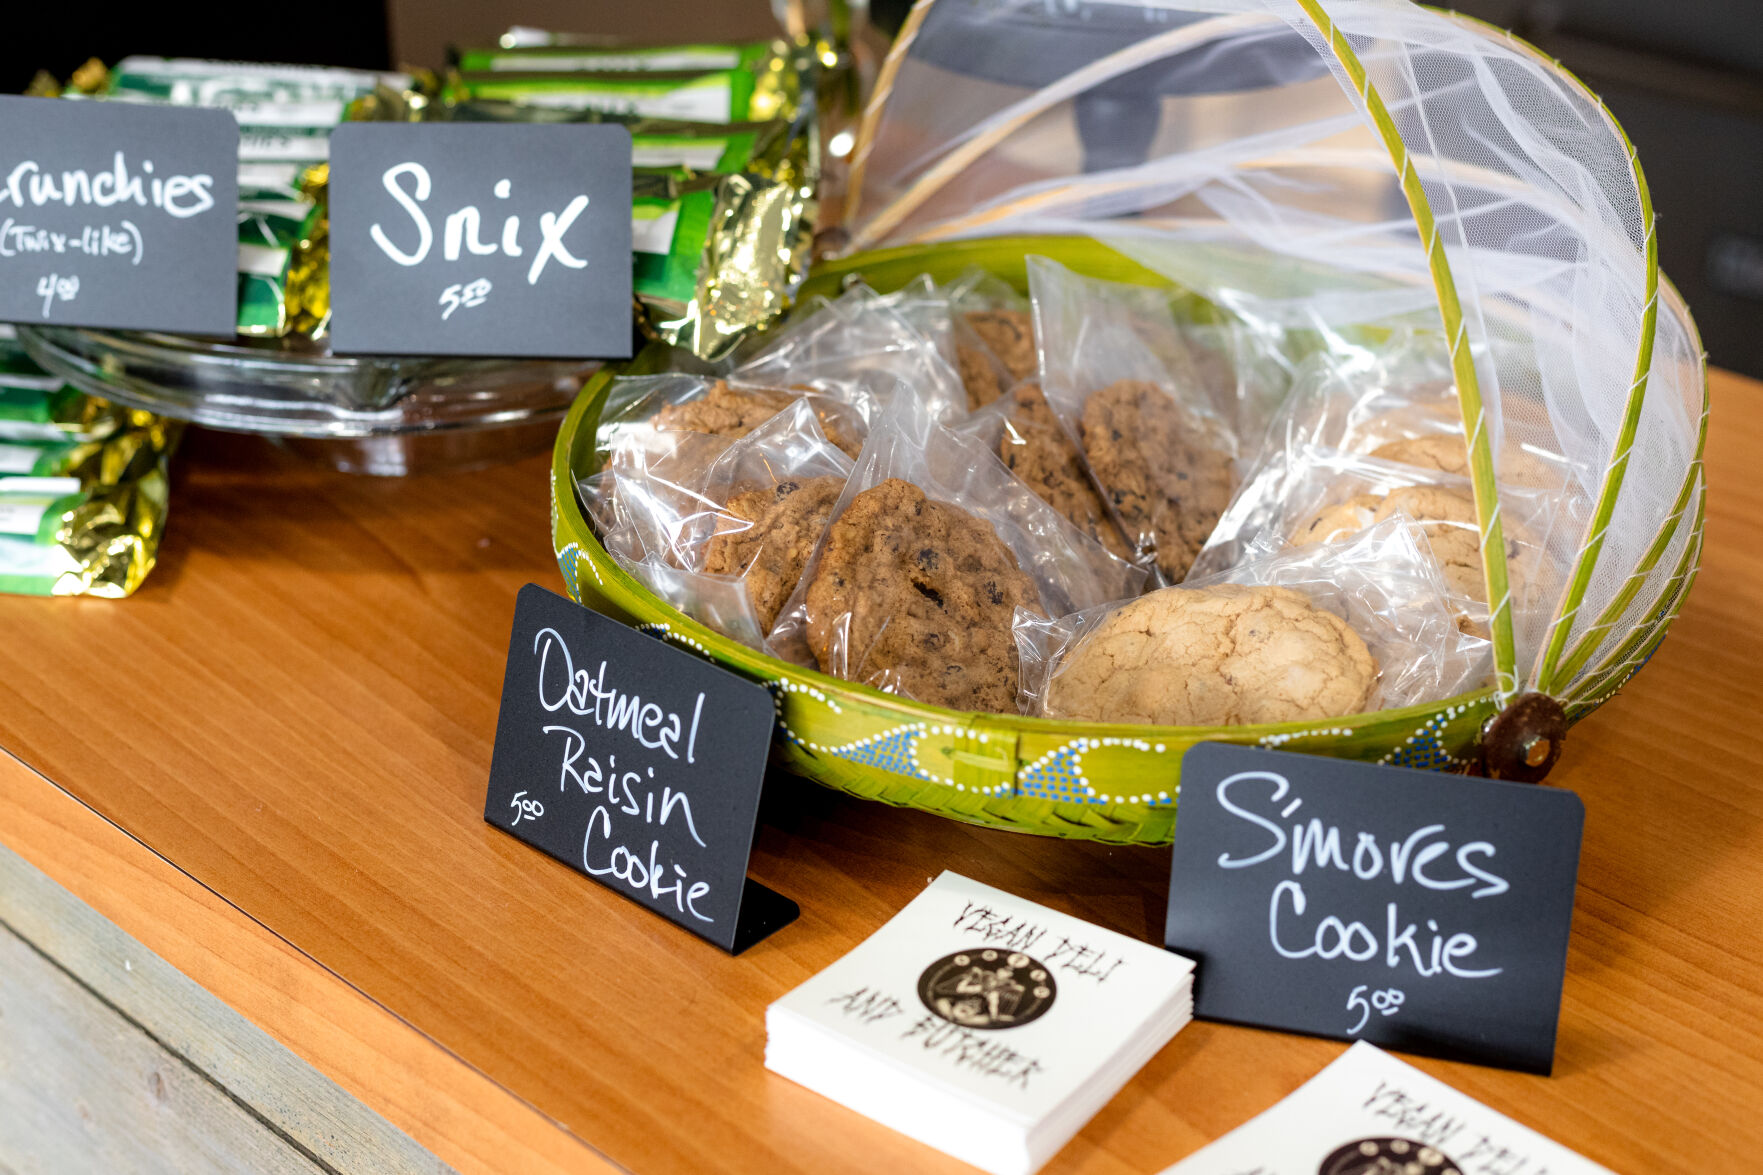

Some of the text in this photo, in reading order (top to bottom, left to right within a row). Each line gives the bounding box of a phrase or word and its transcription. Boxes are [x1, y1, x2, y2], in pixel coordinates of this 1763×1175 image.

[0, 151, 215, 218] runchies
[370, 162, 590, 285] Snix
[534, 628, 706, 763] Oatmeal
[543, 726, 707, 848] Raisin
[1216, 771, 1510, 898] S'mores
[583, 806, 714, 922] Cookie
[952, 899, 1127, 984] VEGAN DELI
[1270, 880, 1504, 978] Cookie
[824, 985, 904, 1024] AND
